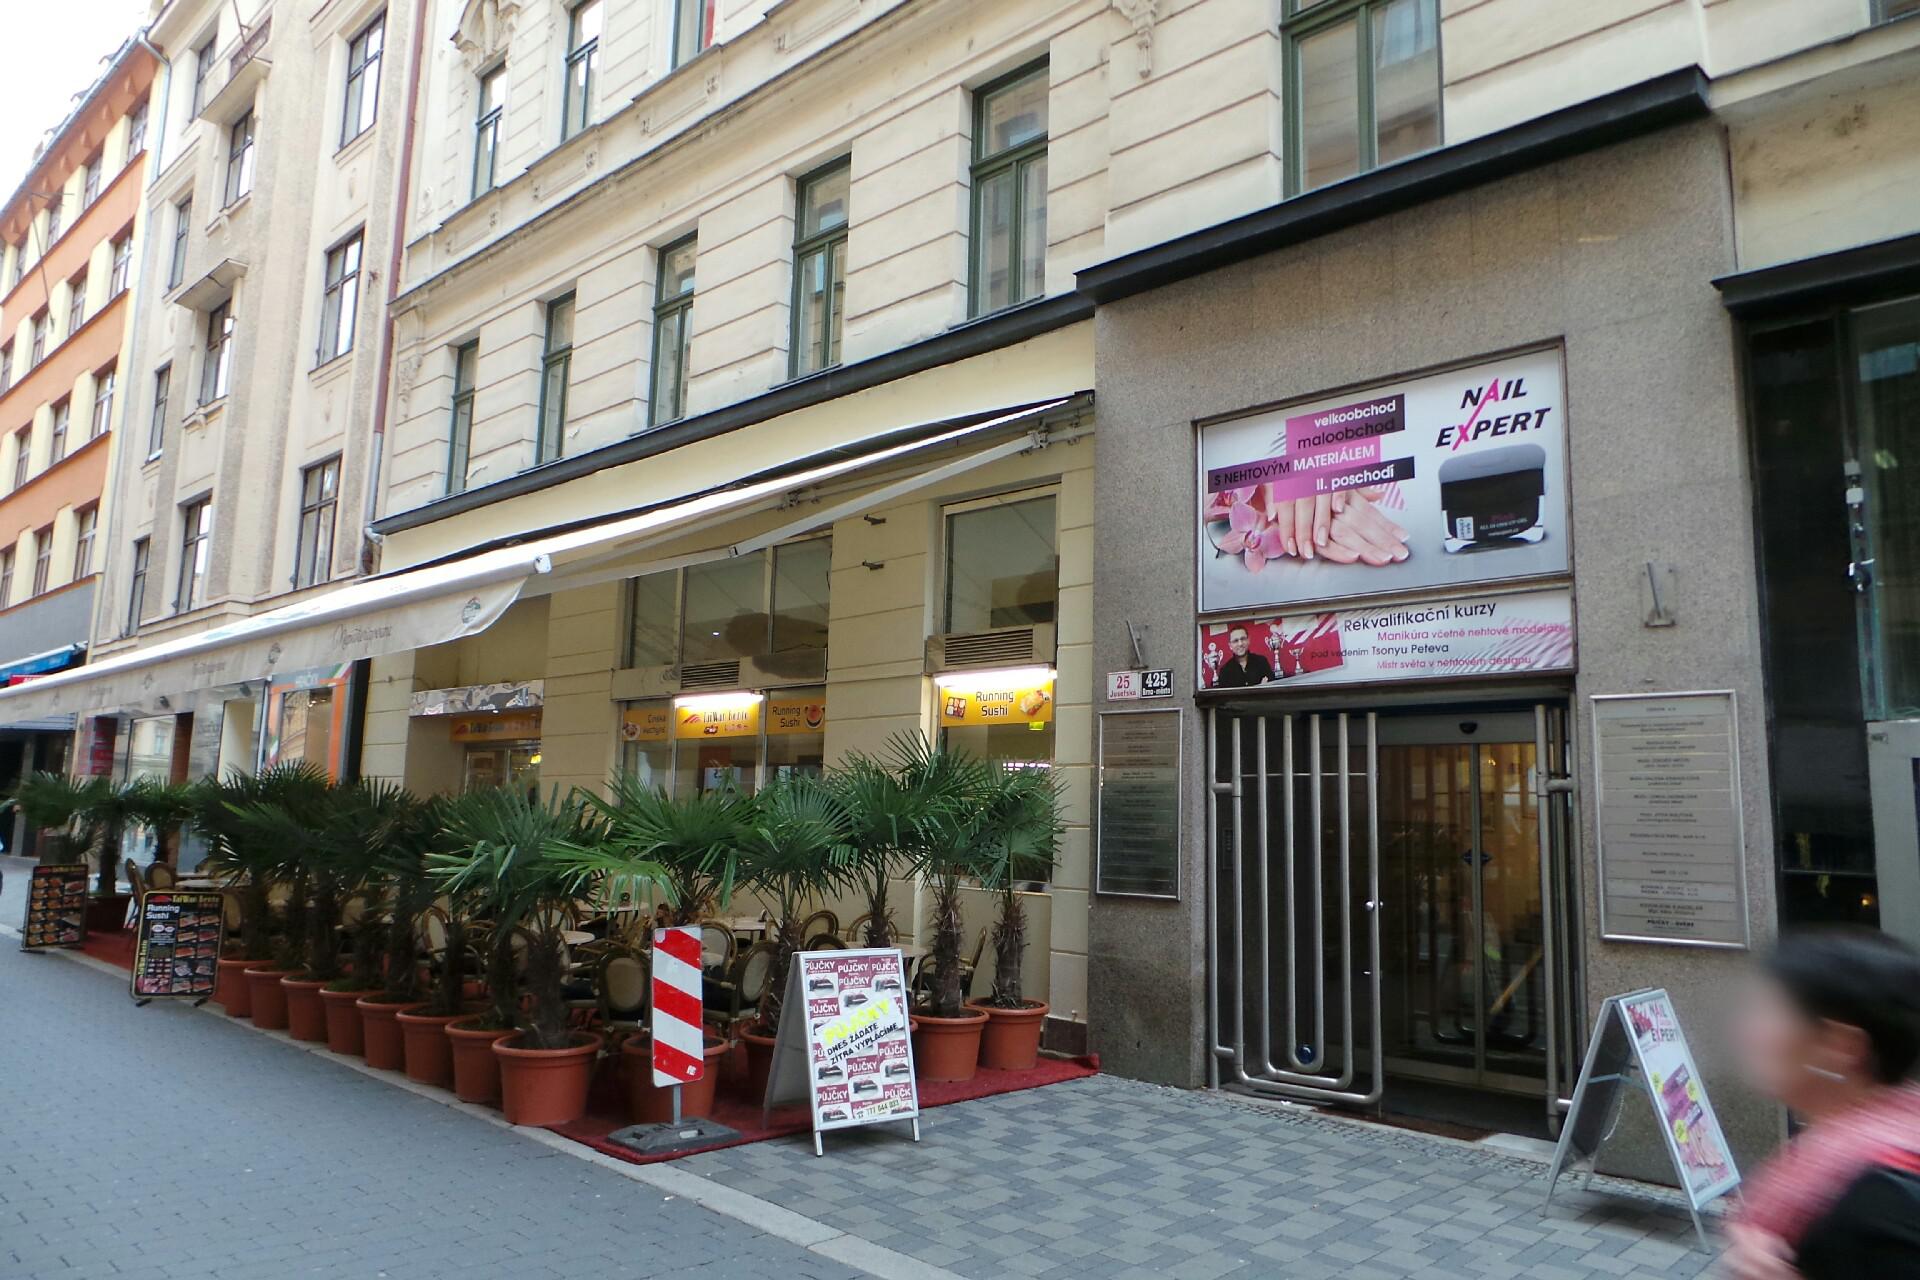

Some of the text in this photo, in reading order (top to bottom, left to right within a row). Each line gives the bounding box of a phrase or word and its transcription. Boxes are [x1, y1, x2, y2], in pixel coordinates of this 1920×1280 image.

[1460, 377, 1528, 409] NAIL
[1314, 399, 1396, 428] velkoobchod
[1297, 417, 1395, 449] maloobchod
[1435, 407, 1552, 448] EXPERT
[1214, 444, 1376, 486] S NEHTOVÝM MATERIÁLEM
[1331, 463, 1395, 491] poschodí
[1344, 601, 1497, 632] Rekvalifikační kurzy
[1377, 628, 1429, 641] Manikúra
[1431, 626, 1466, 639] včetně
[1371, 644, 1408, 656] Tsonyu
[1411, 642, 1449, 654] Peteva
[1400, 658, 1425, 668] světa
[1117, 675, 1130, 689] 25
[1145, 672, 1168, 687] 425
[975, 691, 1014, 702] Running
[772, 706, 801, 717] Running
[981, 705, 1008, 716] Sushi
[780, 718, 801, 728] Sushi
[146, 912, 169, 920] Sushi
[147, 904, 180, 914] Running
[837, 963, 869, 973] PŮJČKY
[839, 976, 870, 986] PŮJČKY
[827, 1039, 848, 1056] DNES
[830, 1046, 854, 1065] ZÍTRA
[847, 1060, 878, 1073] PŮJČKY
[884, 1087, 912, 1100] PŮJČK
